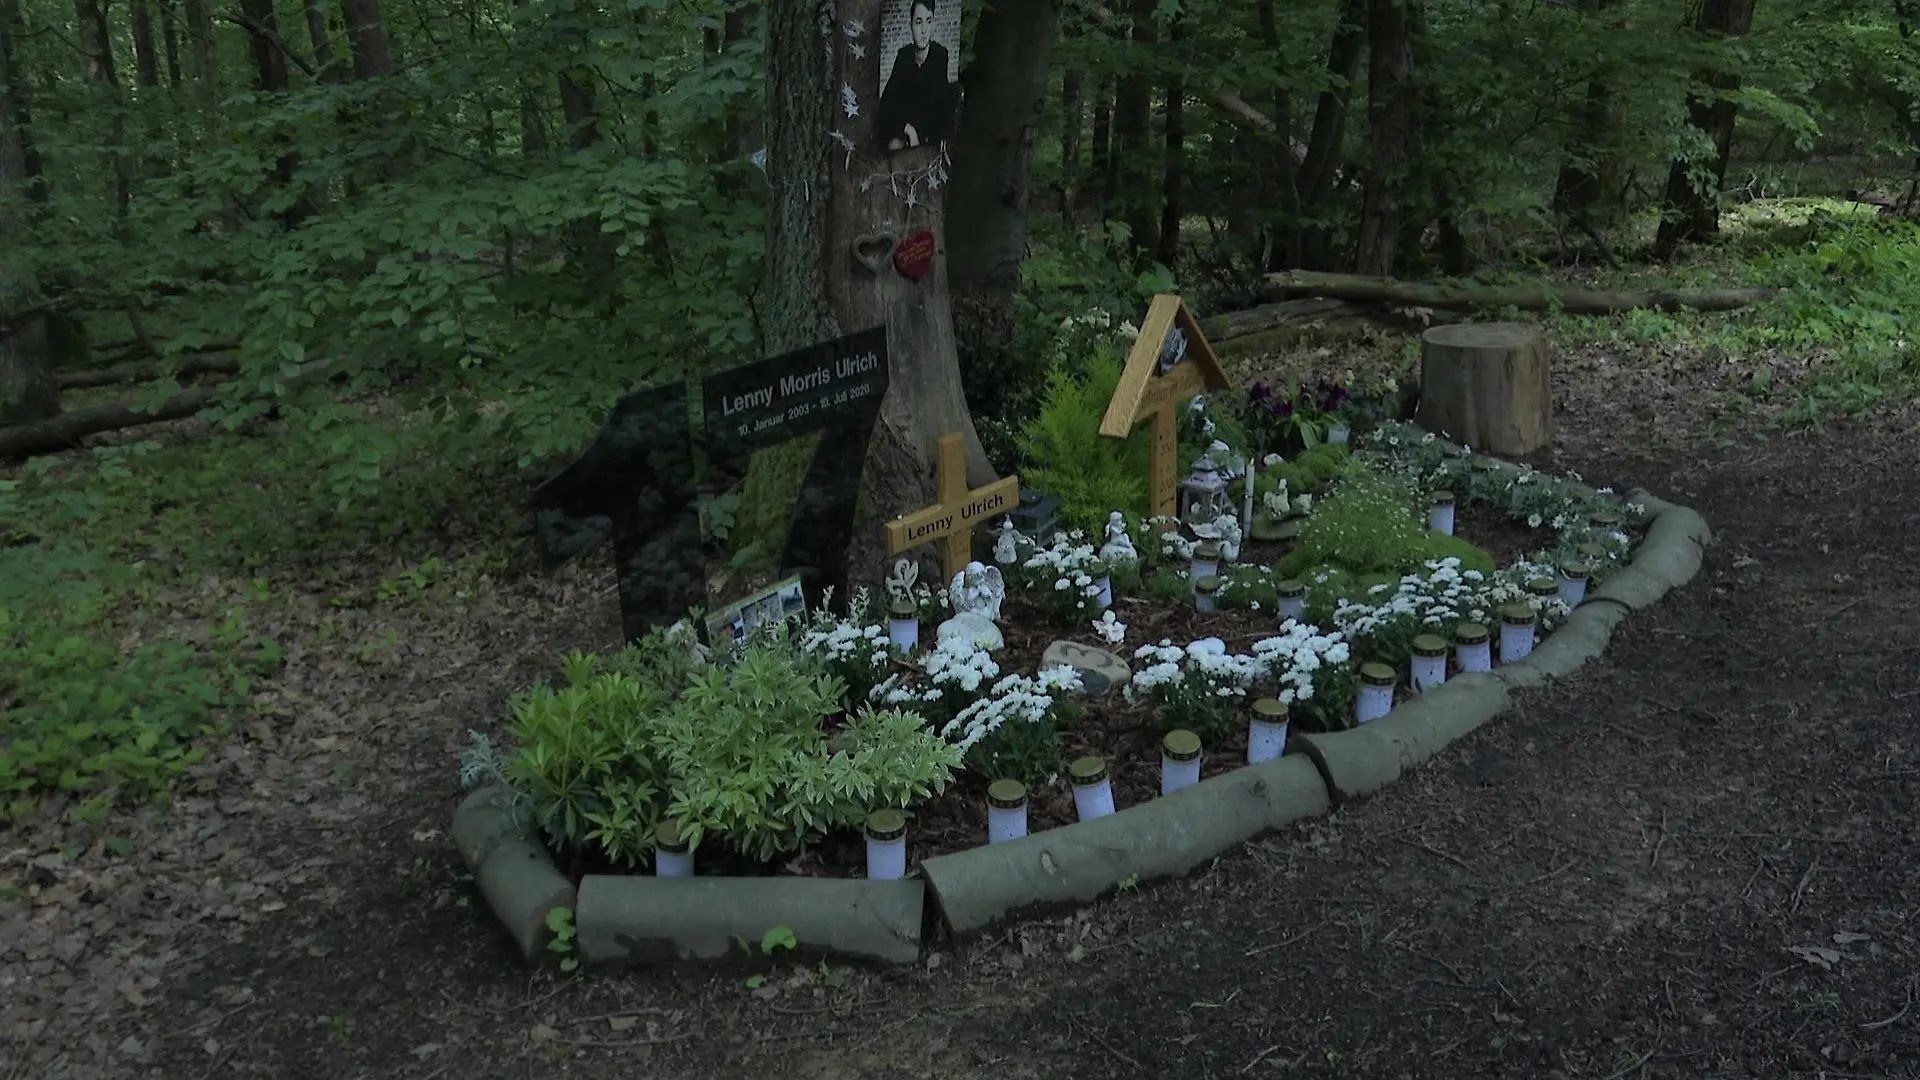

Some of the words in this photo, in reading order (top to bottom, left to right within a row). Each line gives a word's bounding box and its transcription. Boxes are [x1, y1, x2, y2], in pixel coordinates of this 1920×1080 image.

[722, 385, 774, 416] Lenny
[779, 366, 831, 398] Morris
[835, 351, 878, 379] Ulrich
[737, 424, 751, 438] 10.
[753, 412, 785, 432] Januar
[788, 403, 810, 421] 2003
[820, 396, 832, 409] 10.
[850, 383, 870, 400] 2020
[908, 515, 953, 540] Lenny
[960, 494, 1003, 519] Ulrich
